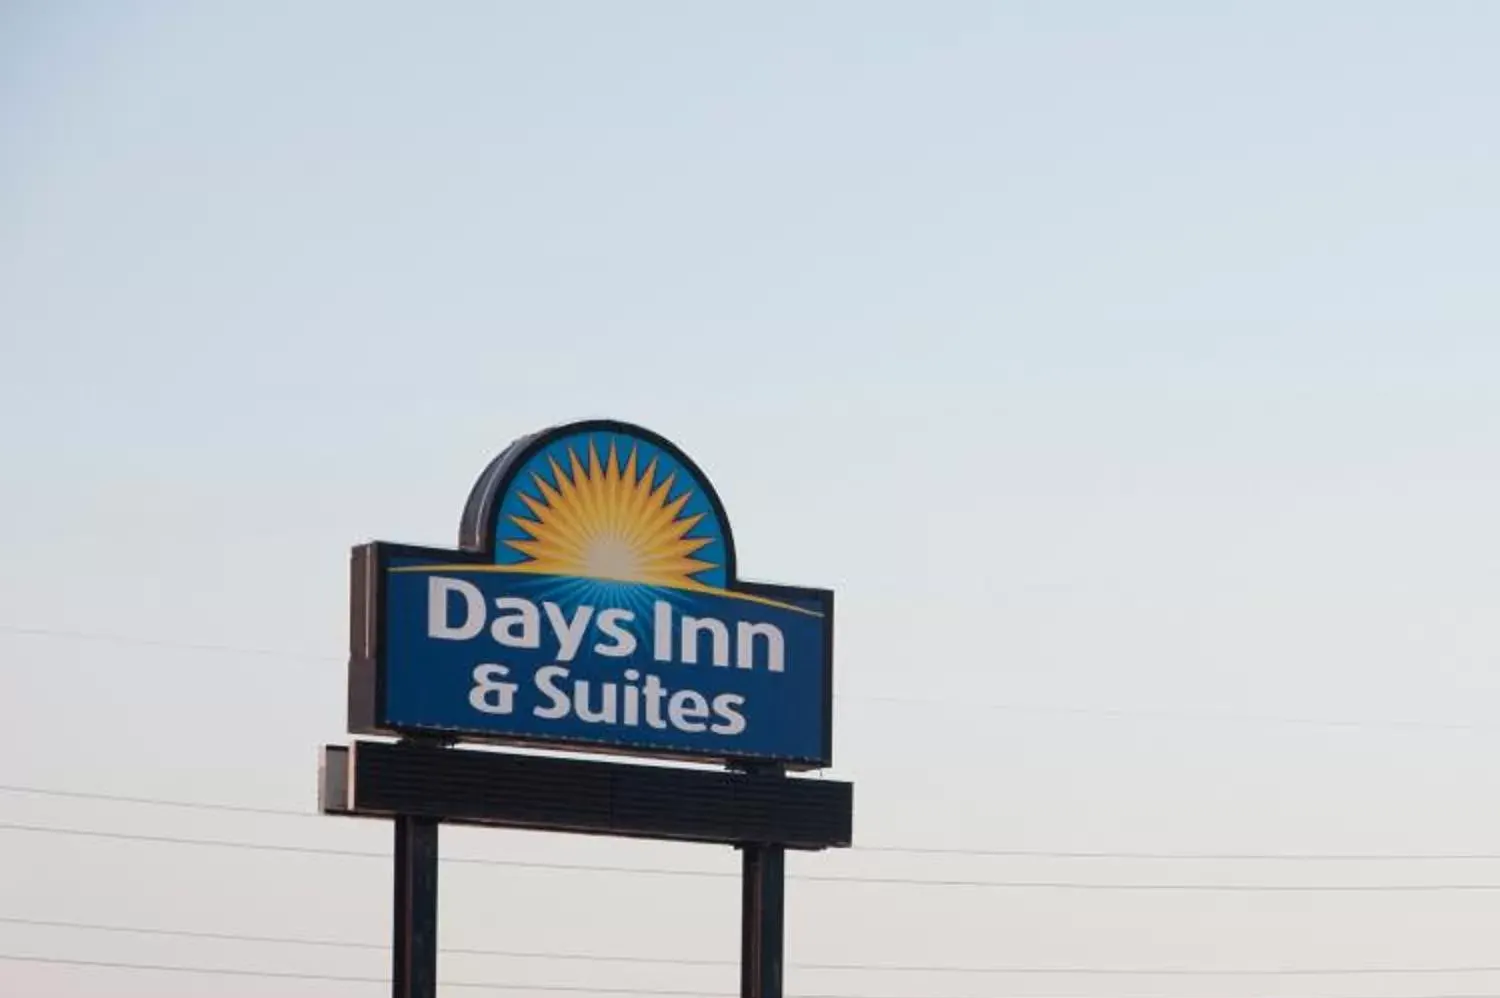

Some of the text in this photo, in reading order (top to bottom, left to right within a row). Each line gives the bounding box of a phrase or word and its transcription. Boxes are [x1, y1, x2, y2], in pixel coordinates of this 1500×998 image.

[427, 576, 785, 673] Days Inn
[468, 663, 746, 736] & Suites
